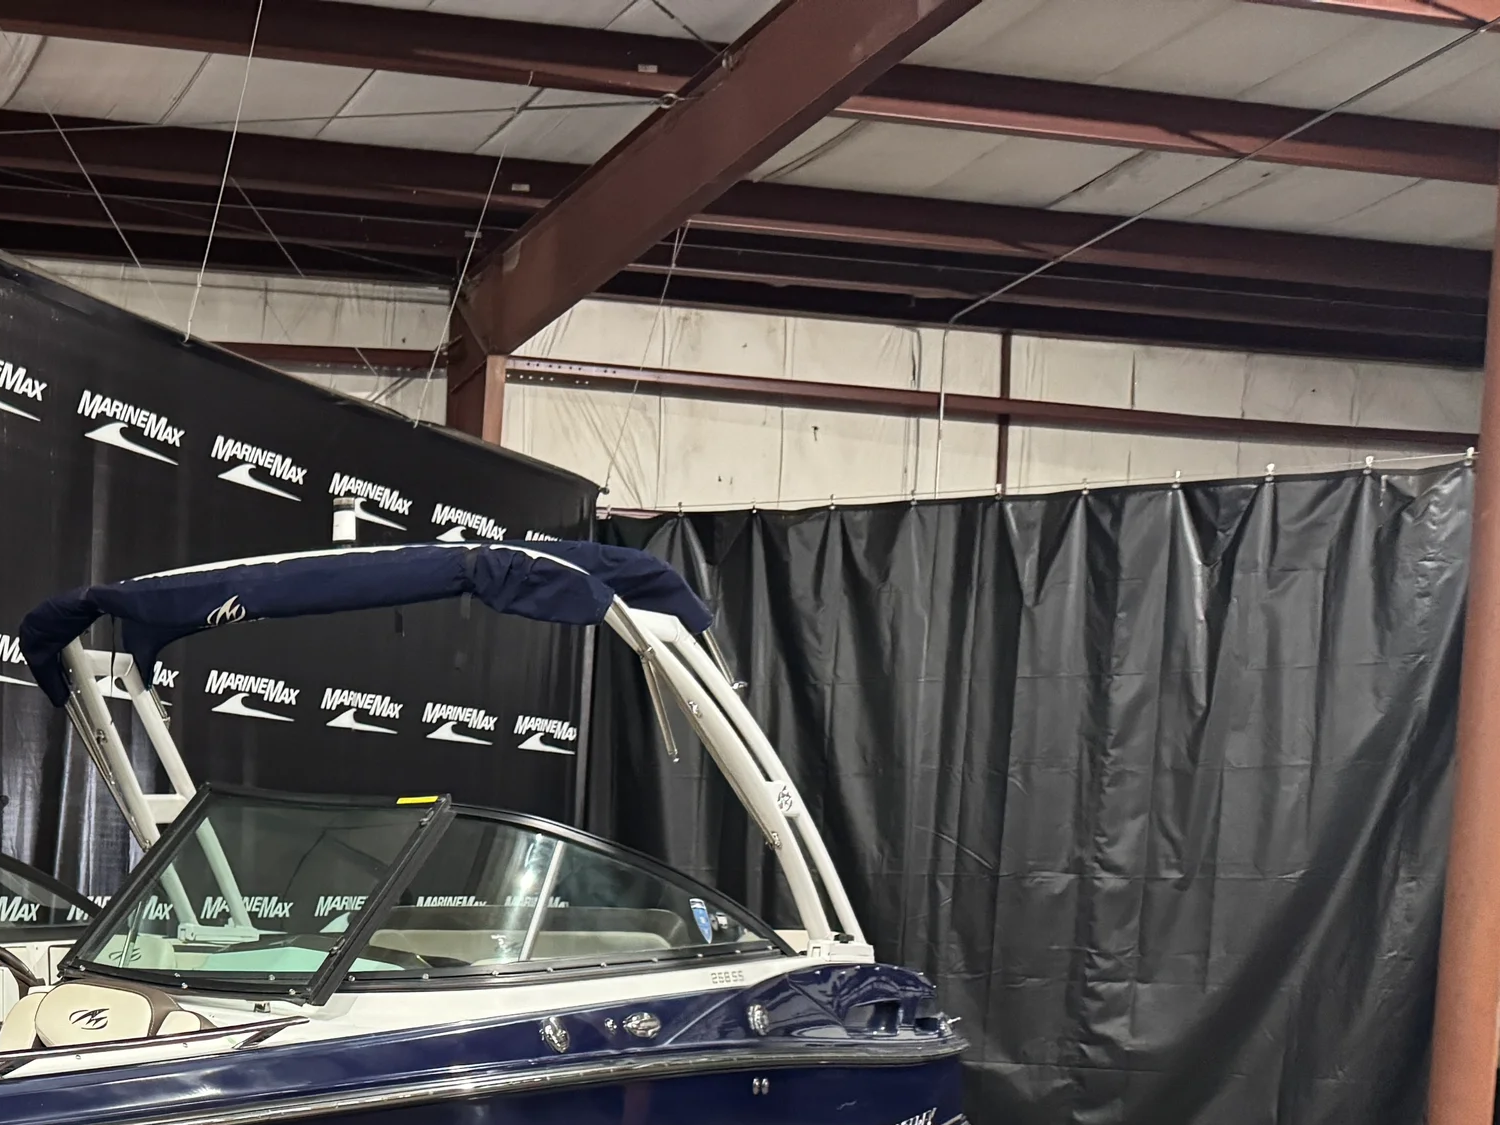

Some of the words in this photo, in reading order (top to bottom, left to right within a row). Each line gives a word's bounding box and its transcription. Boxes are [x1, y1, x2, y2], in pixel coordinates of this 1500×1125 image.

[77, 390, 185, 448] MARINEMAX
[211, 435, 307, 486] MARINEMAX
[328, 472, 412, 516] MARINEMAX
[431, 503, 507, 541] MARINEMAX
[206, 669, 300, 707] MARINEMAX
[320, 687, 403, 719] MARINEMAX
[422, 702, 498, 731] MARINEMAX
